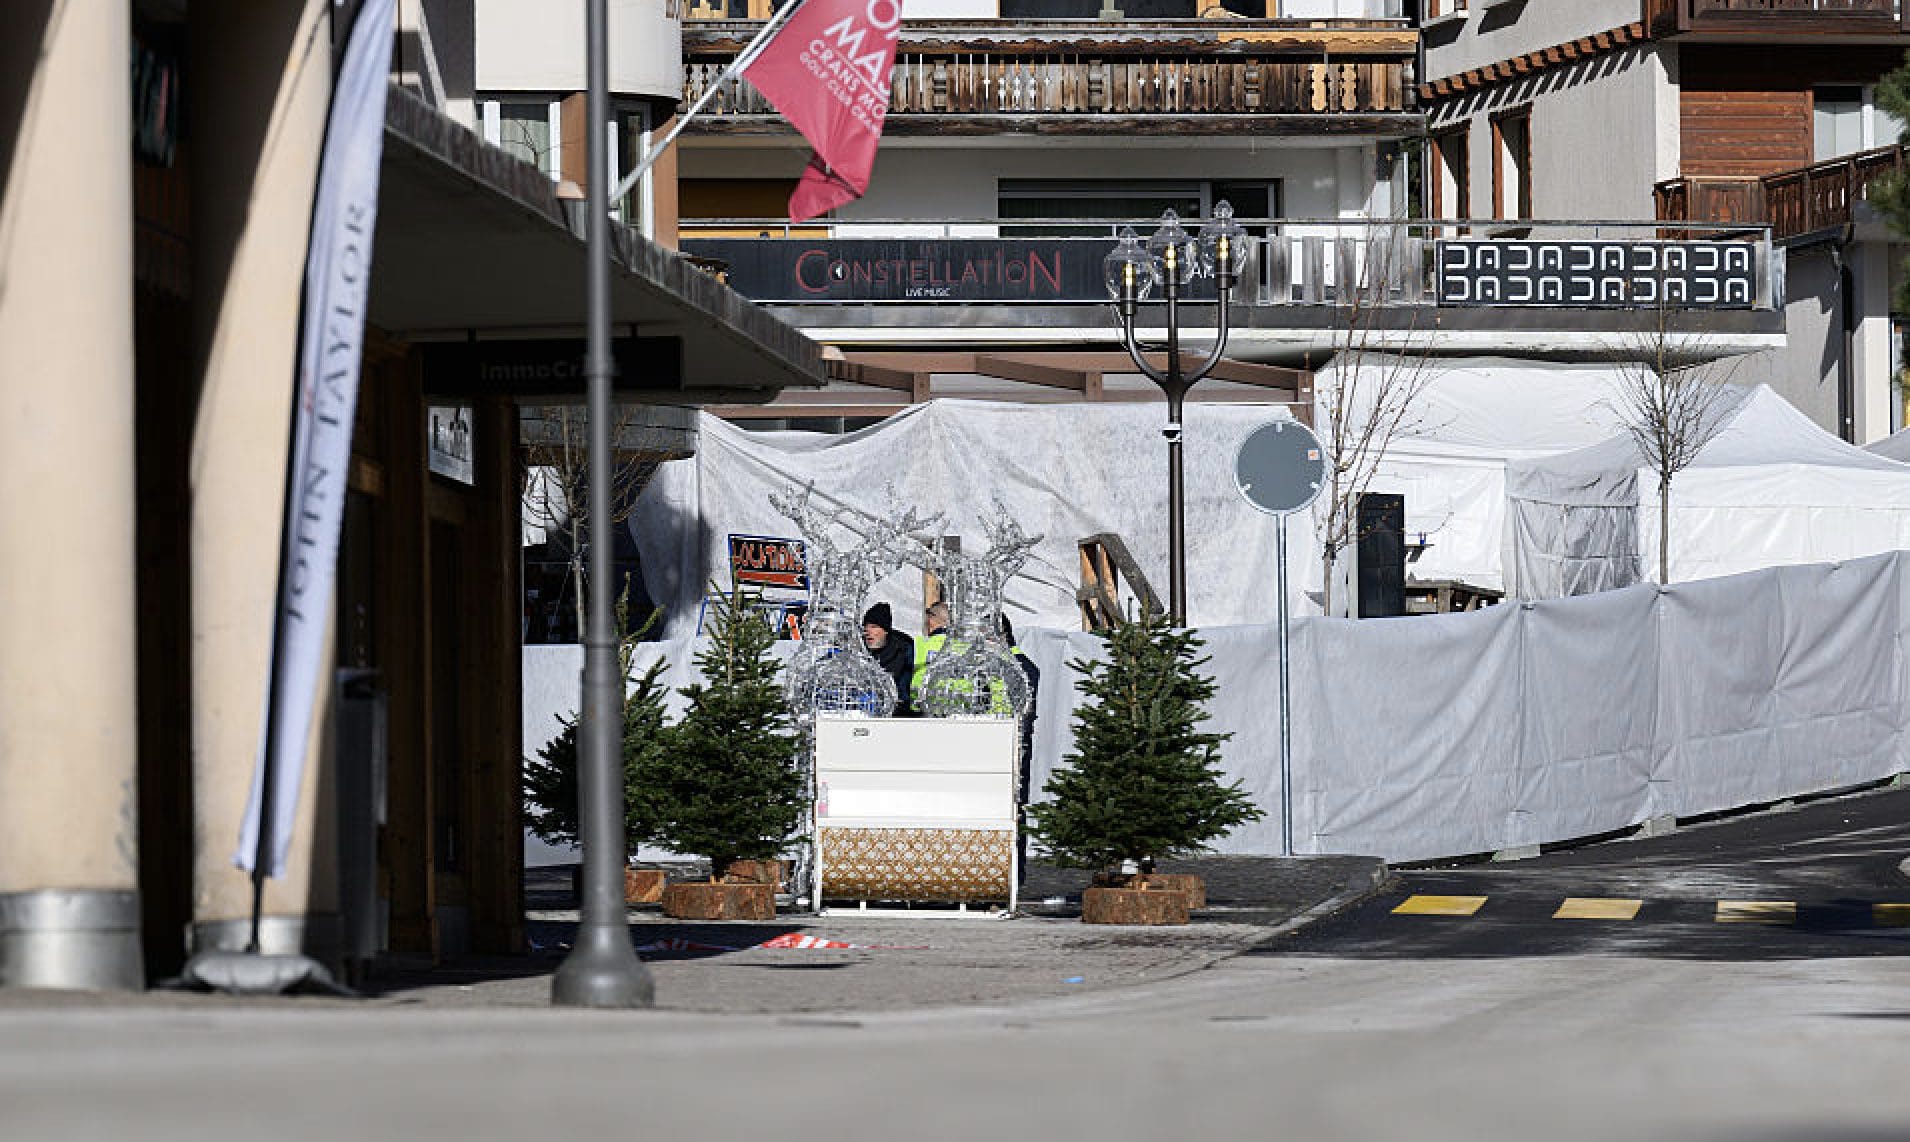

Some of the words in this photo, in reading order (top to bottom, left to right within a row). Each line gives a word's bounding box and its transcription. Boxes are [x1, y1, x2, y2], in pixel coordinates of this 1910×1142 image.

[809, 39, 860, 91] CRANS
[905, 287, 922, 297] LIVE
[924, 287, 951, 297] MUSIC
[286, 465, 328, 623] JOHN
[317, 203, 364, 428] TAYLOR
